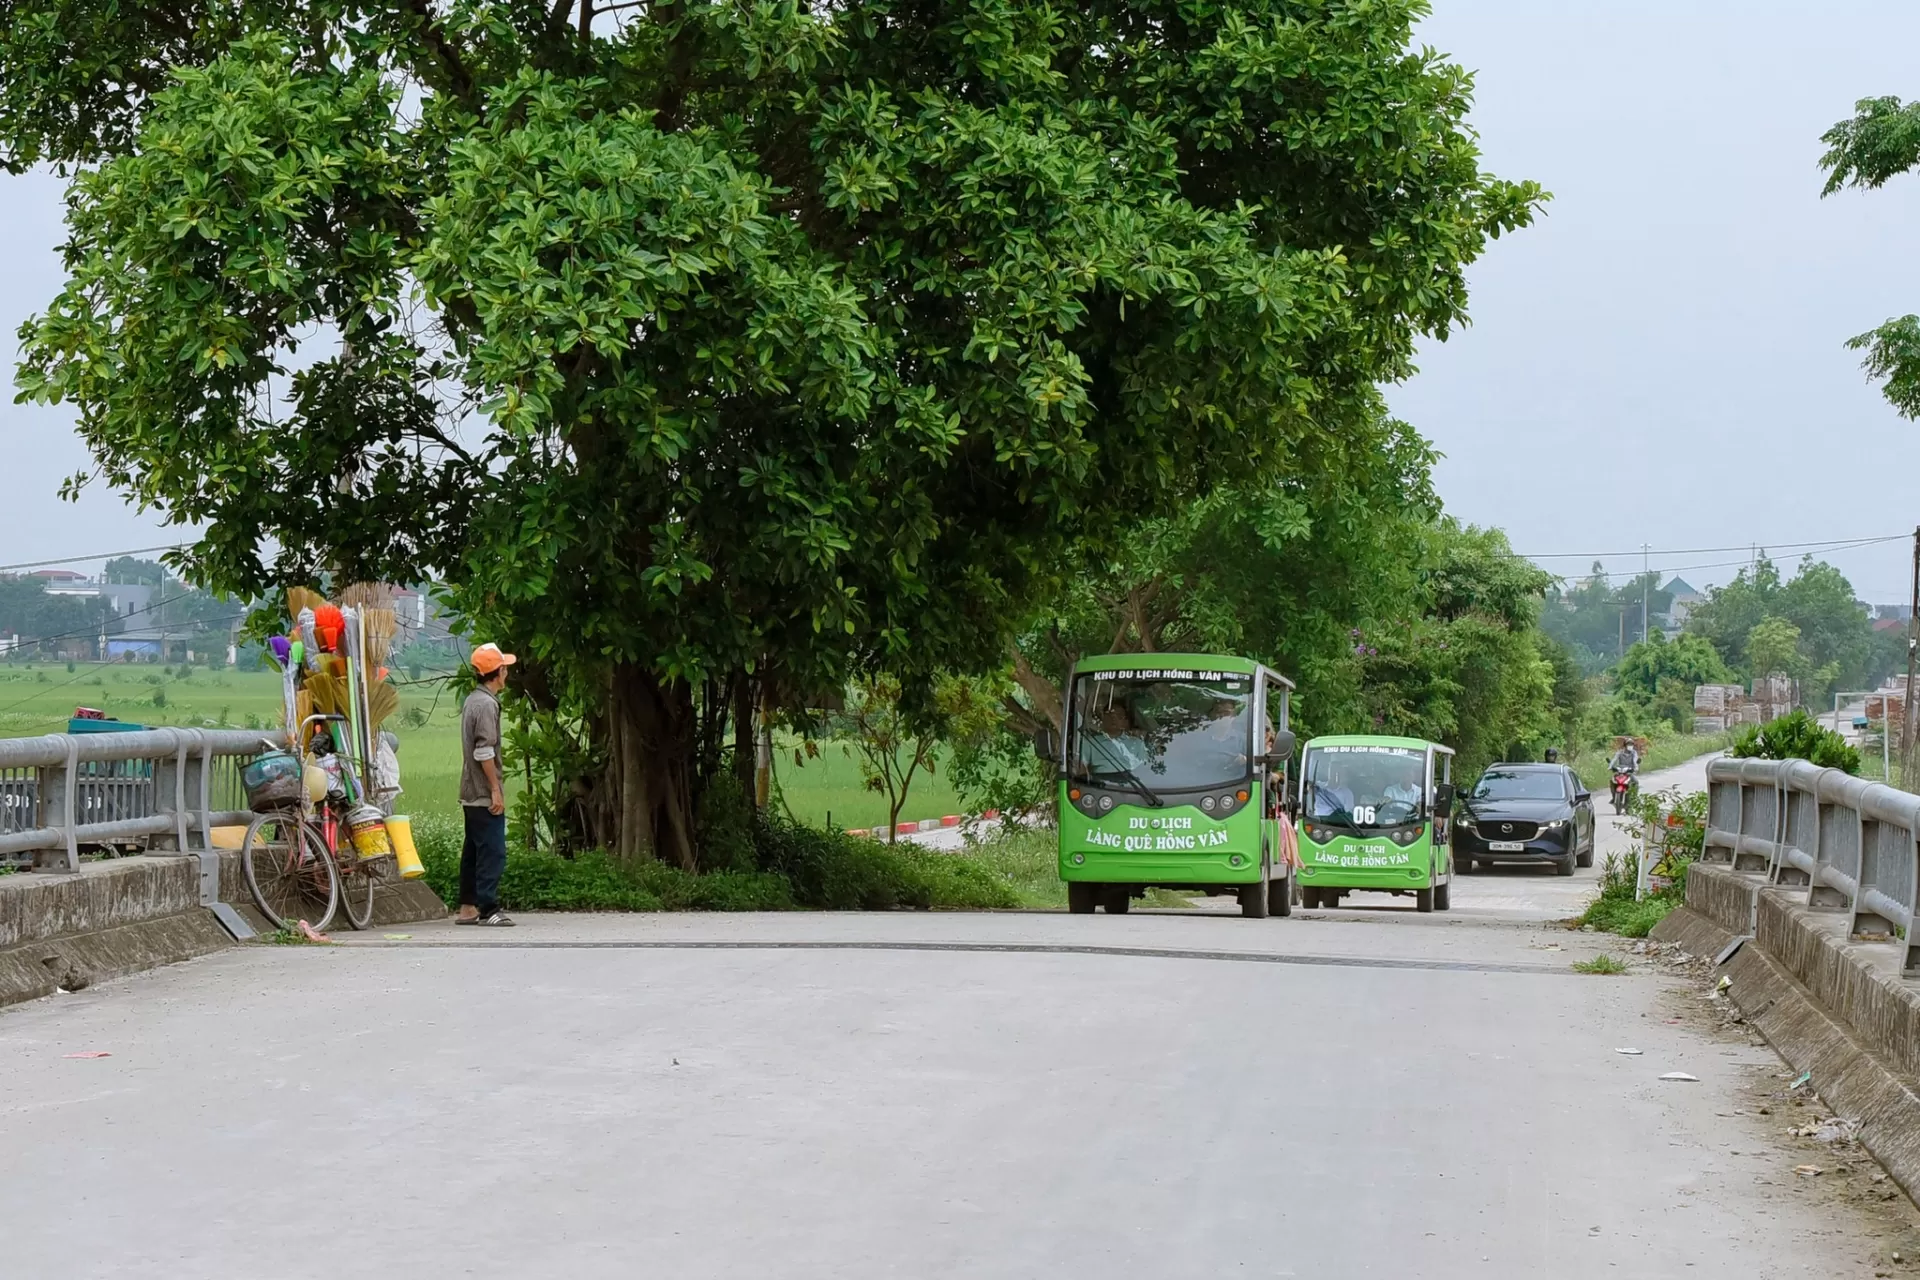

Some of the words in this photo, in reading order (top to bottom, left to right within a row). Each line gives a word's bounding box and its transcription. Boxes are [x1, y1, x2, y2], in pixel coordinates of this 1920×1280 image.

[1094, 671, 1116, 681] KHU
[1136, 670, 1160, 680] LỊCH
[1199, 670, 1221, 681] VÂN
[1353, 805, 1376, 825] 06
[1129, 817, 1148, 829] DU
[1161, 817, 1192, 831] LỊCH
[1086, 827, 1121, 847] LÀNG
[1124, 833, 1152, 851] QUÊ
[1156, 830, 1195, 850] HỒNG
[1198, 829, 1228, 847] VÂN
[1343, 844, 1356, 853] DU
[1365, 845, 1385, 855] LỊCH
[1315, 850, 1339, 864] LÀNG
[1340, 855, 1360, 867] QUÊ
[1388, 853, 1409, 865] VÂN
